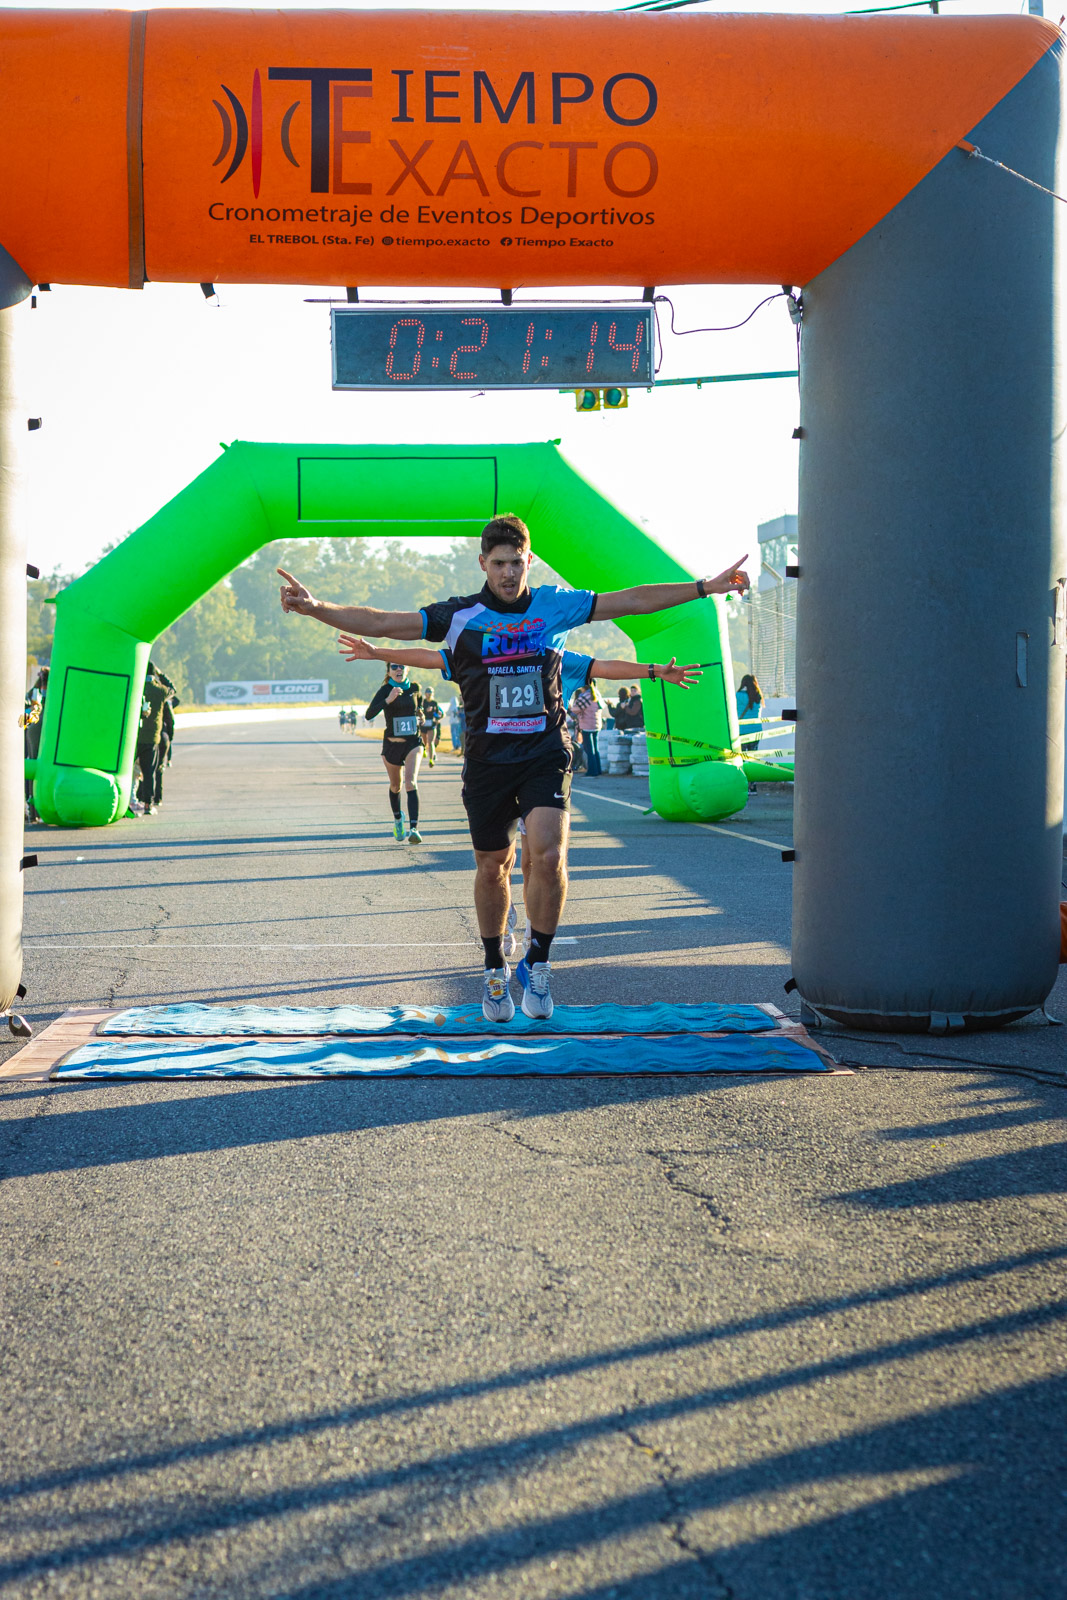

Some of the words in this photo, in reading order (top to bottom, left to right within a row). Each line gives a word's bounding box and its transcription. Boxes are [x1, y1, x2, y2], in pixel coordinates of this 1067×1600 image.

[208, 202, 373, 228] Cronometraje
[379, 204, 410, 224] de
[417, 205, 513, 225] Eventos
[520, 206, 655, 229] Deportivos
[249, 234, 265, 244] EL
[267, 234, 319, 245] TREBOL
[322, 235, 352, 246] (Sta.
[355, 235, 375, 246] Fe)
[396, 236, 491, 248] tiempo.exacto
[515, 237, 566, 249] Tiempo
[569, 237, 614, 247] Exacto
[386, 317, 645, 380] 0:21:14
[487, 665, 516, 675] RAFAELA,
[516, 664, 536, 674] SANTA
[216, 683, 240, 697] Ford
[274, 684, 320, 694] LONG
[501, 684, 535, 708] 129
[400, 721, 411, 732] 21
[526, 717, 543, 727] Salud
